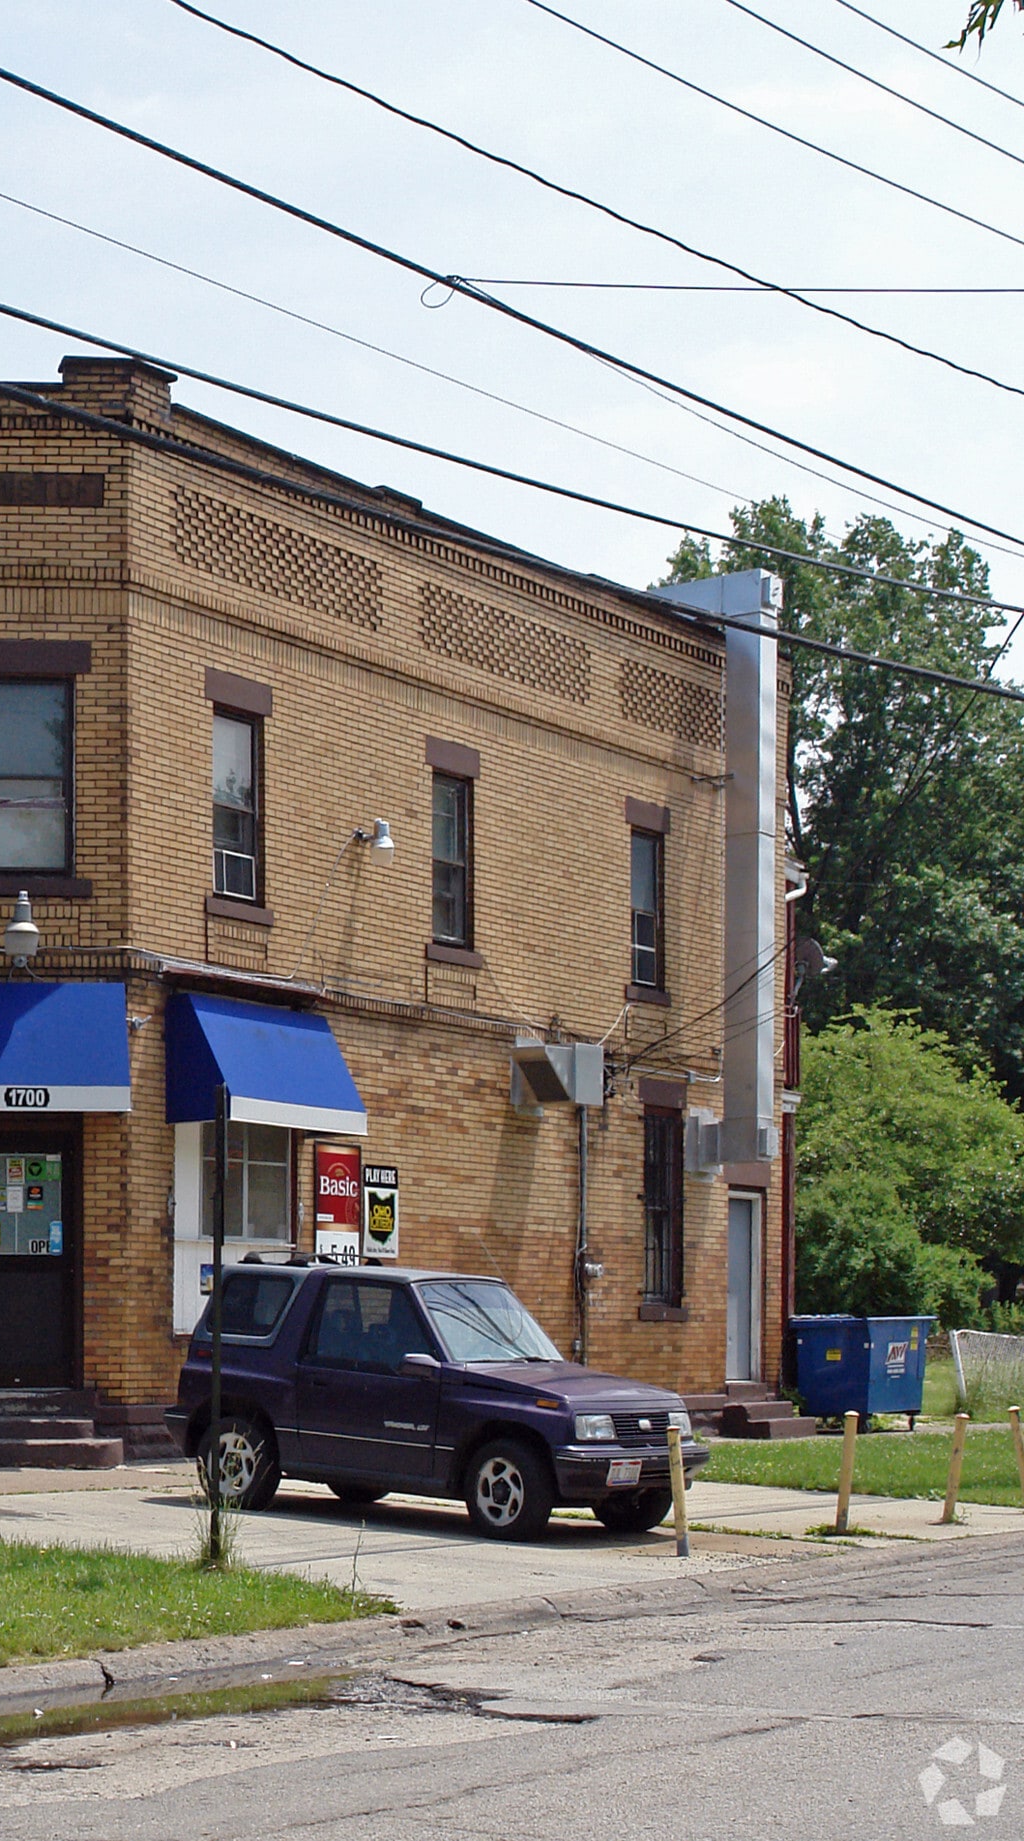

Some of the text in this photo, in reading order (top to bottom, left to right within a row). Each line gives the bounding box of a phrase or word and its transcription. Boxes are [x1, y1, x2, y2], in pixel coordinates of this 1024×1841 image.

[9, 1089, 45, 1106] 1700
[365, 1167, 380, 1183] PLAY
[380, 1169, 397, 1185] HERE
[319, 1175, 358, 1197] Basic
[31, 1240, 50, 1253] OPE
